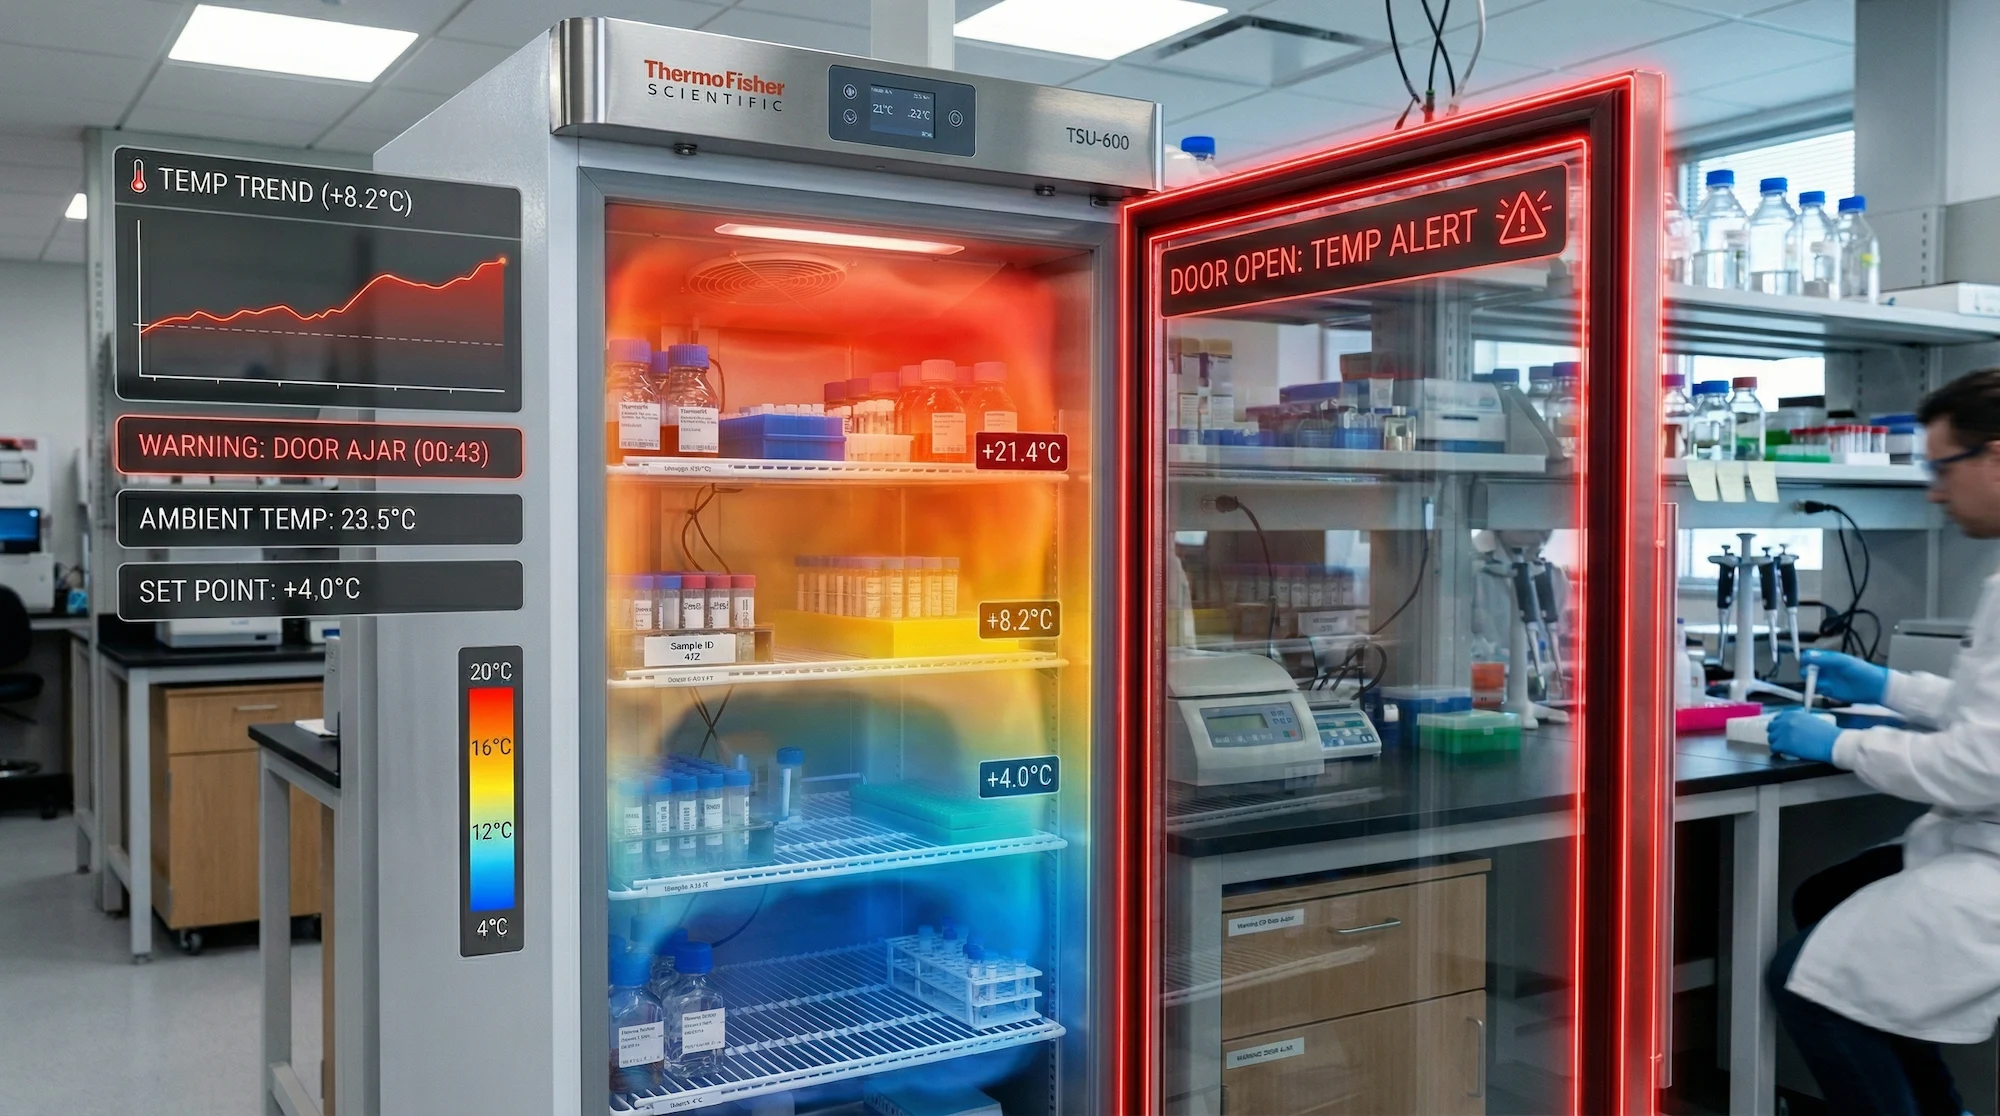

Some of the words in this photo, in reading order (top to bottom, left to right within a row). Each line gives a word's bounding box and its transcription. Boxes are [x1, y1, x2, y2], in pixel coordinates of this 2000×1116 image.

[644, 59, 786, 96] ThermoFisher
[648, 83, 783, 112] SCIENTIFIC
[1066, 127, 1130, 151] TSU-600
[670, 641, 703, 651] Sample
[704, 641, 714, 650] ID
